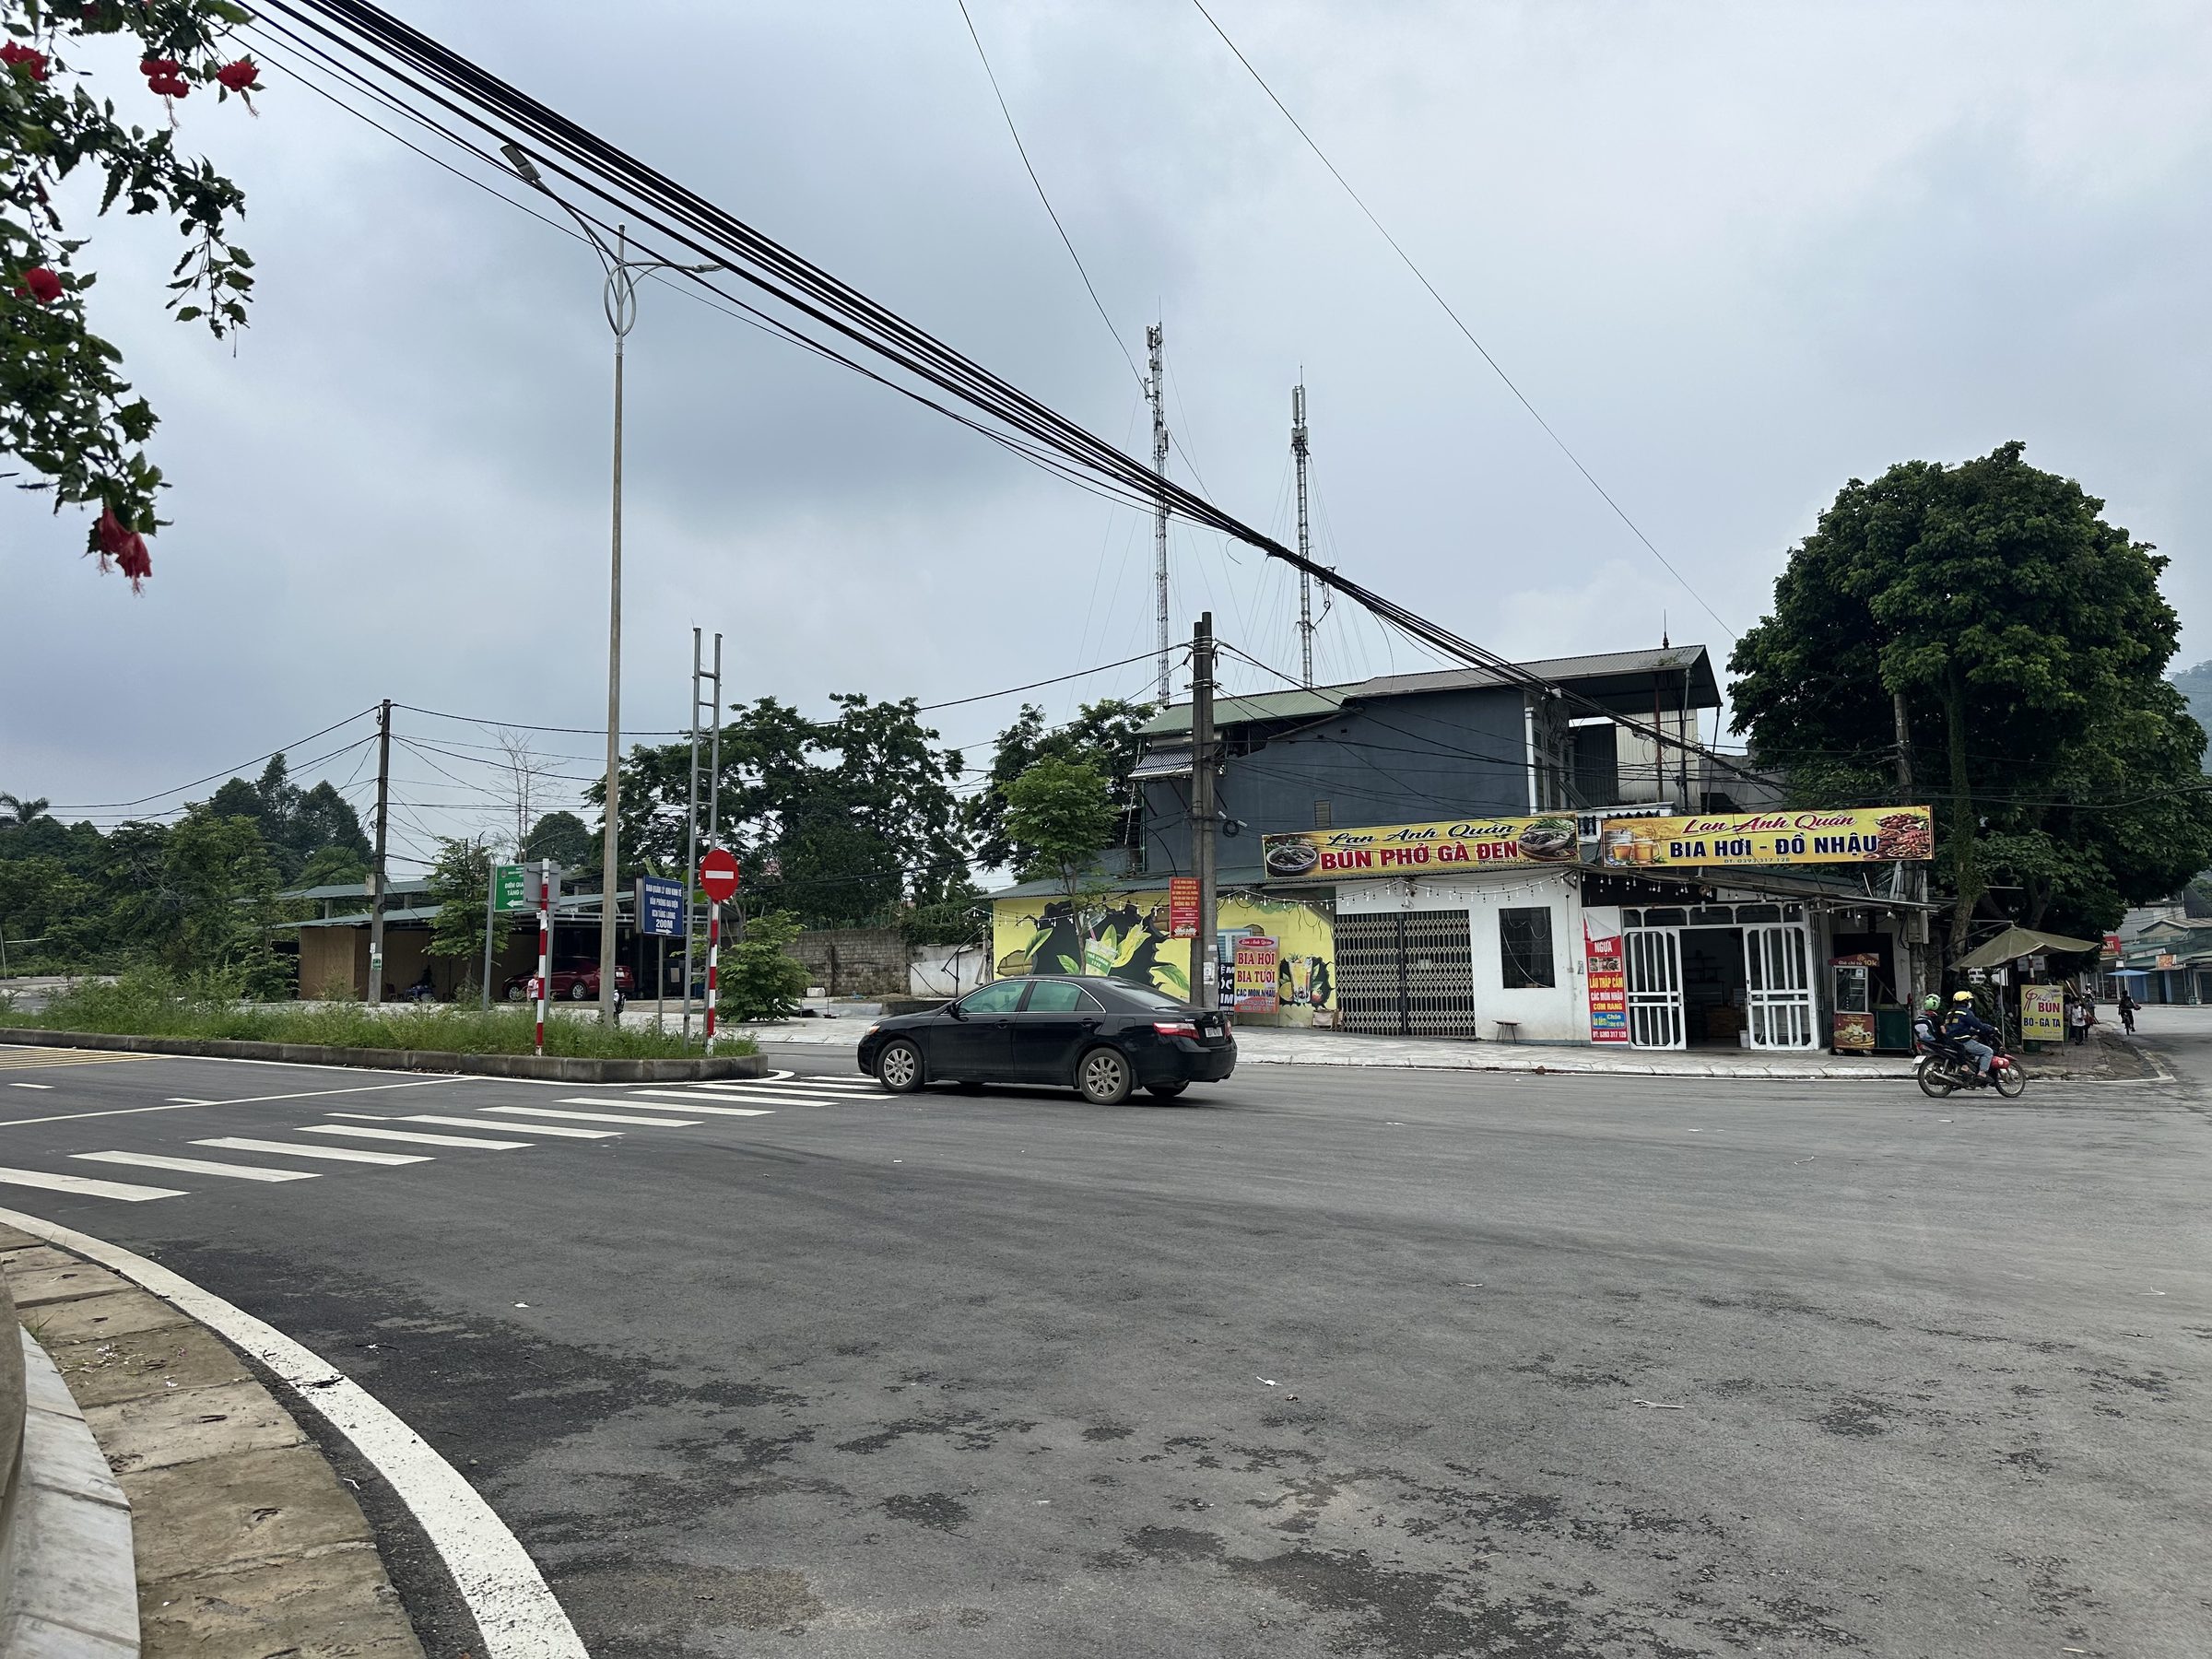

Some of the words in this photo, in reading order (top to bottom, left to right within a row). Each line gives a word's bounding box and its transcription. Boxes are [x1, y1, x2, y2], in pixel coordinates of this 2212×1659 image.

[1682, 819, 1727, 834] Lan
[1733, 817, 1789, 831] Anh
[1794, 814, 1856, 830] Quán
[1326, 833, 1377, 847] Lan
[1385, 828, 1438, 841] Anh
[1447, 823, 1516, 839] Quán
[1670, 841, 1707, 857] BIA
[1714, 839, 1751, 856] HƠI
[1775, 832, 1806, 854] ĐỒ
[1814, 832, 1878, 855] NHẬU
[1320, 847, 1372, 870] BÚN
[1380, 842, 1430, 866] PHỞ
[1437, 841, 1470, 862] GÀ
[1476, 841, 1519, 859] ĐEN
[655, 919, 673, 929] 200M
[1594, 940, 1613, 956] NGỰA
[1238, 952, 1254, 965] BIA
[1257, 950, 1276, 965] HƠI
[1237, 970, 1253, 983] BIA
[1254, 969, 1276, 983] TƯƠI
[2038, 1000, 2060, 1013] BÚN
